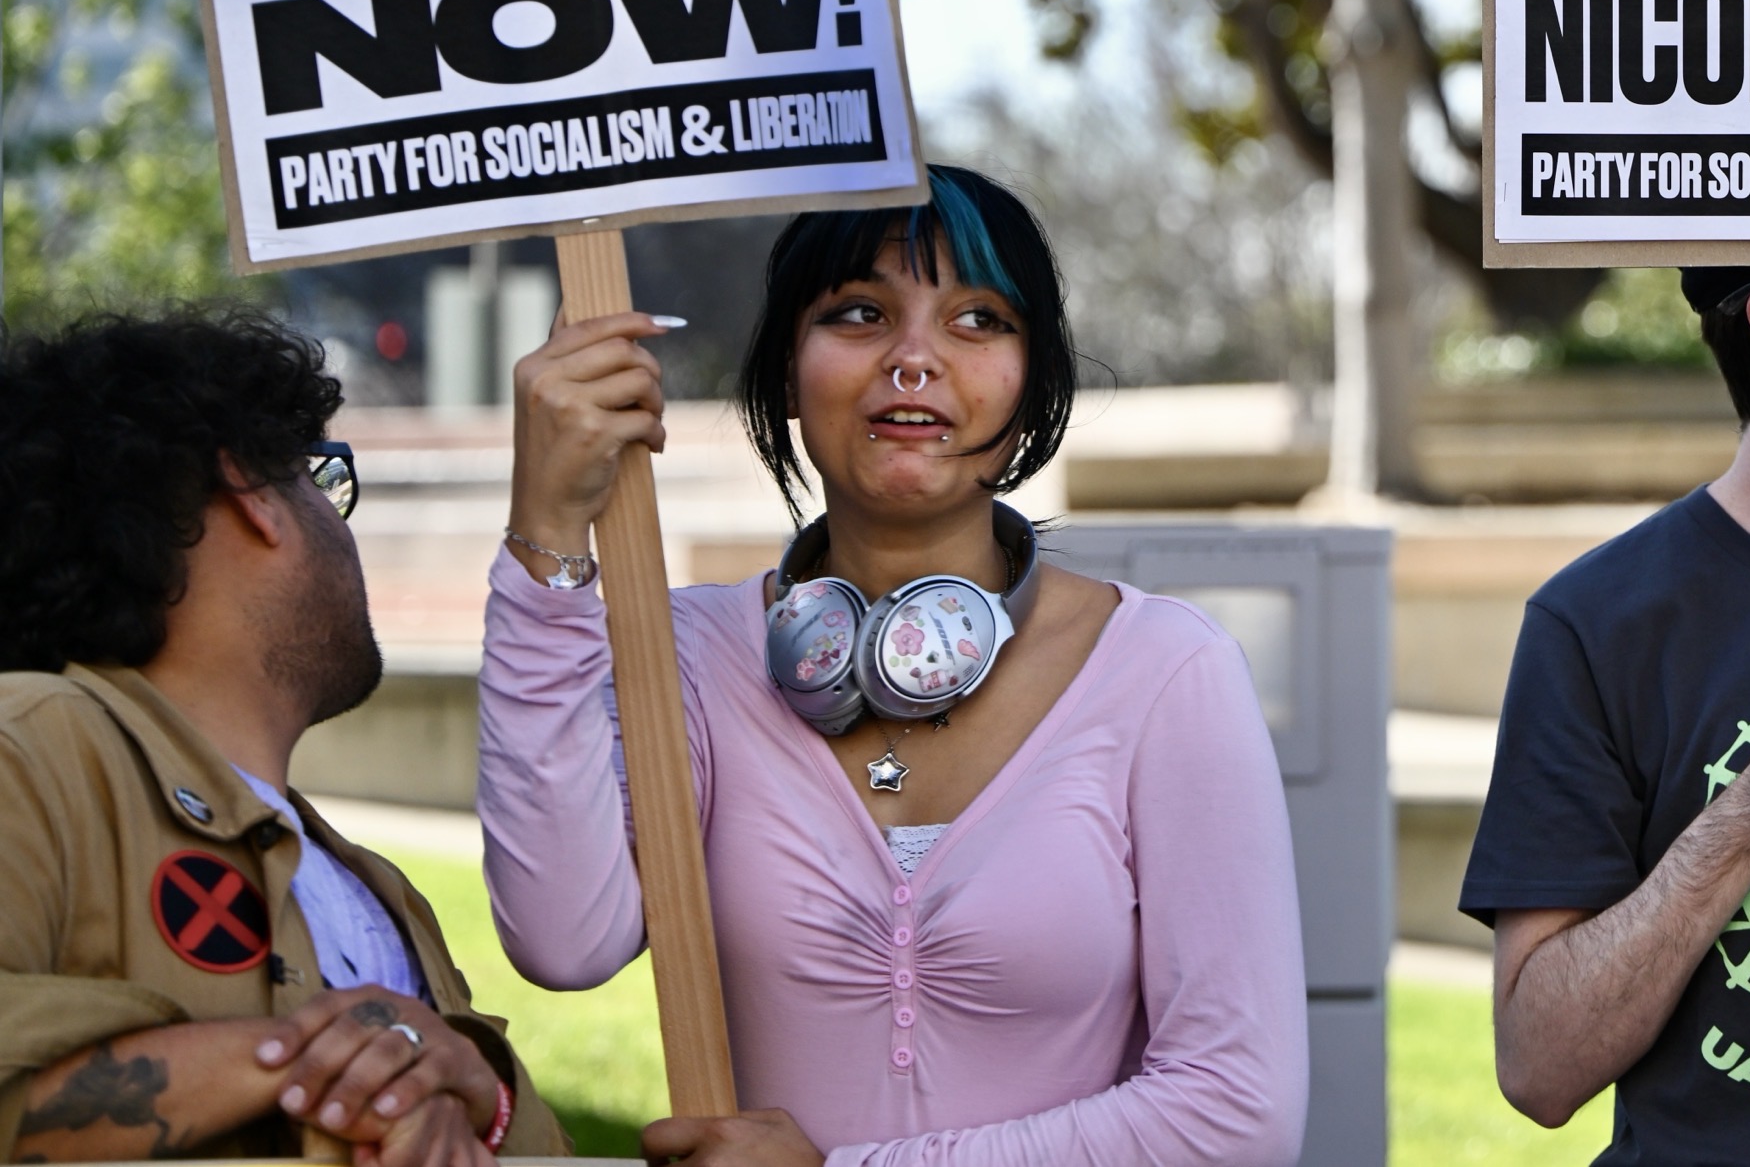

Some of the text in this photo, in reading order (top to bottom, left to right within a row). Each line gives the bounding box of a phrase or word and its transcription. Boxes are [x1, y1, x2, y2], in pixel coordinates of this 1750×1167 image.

[279, 89, 872, 209] PARTY FOR SOCIALISM & LIBERATION
[1533, 152, 1634, 198] PARTY
[1641, 152, 1702, 198] FOR
